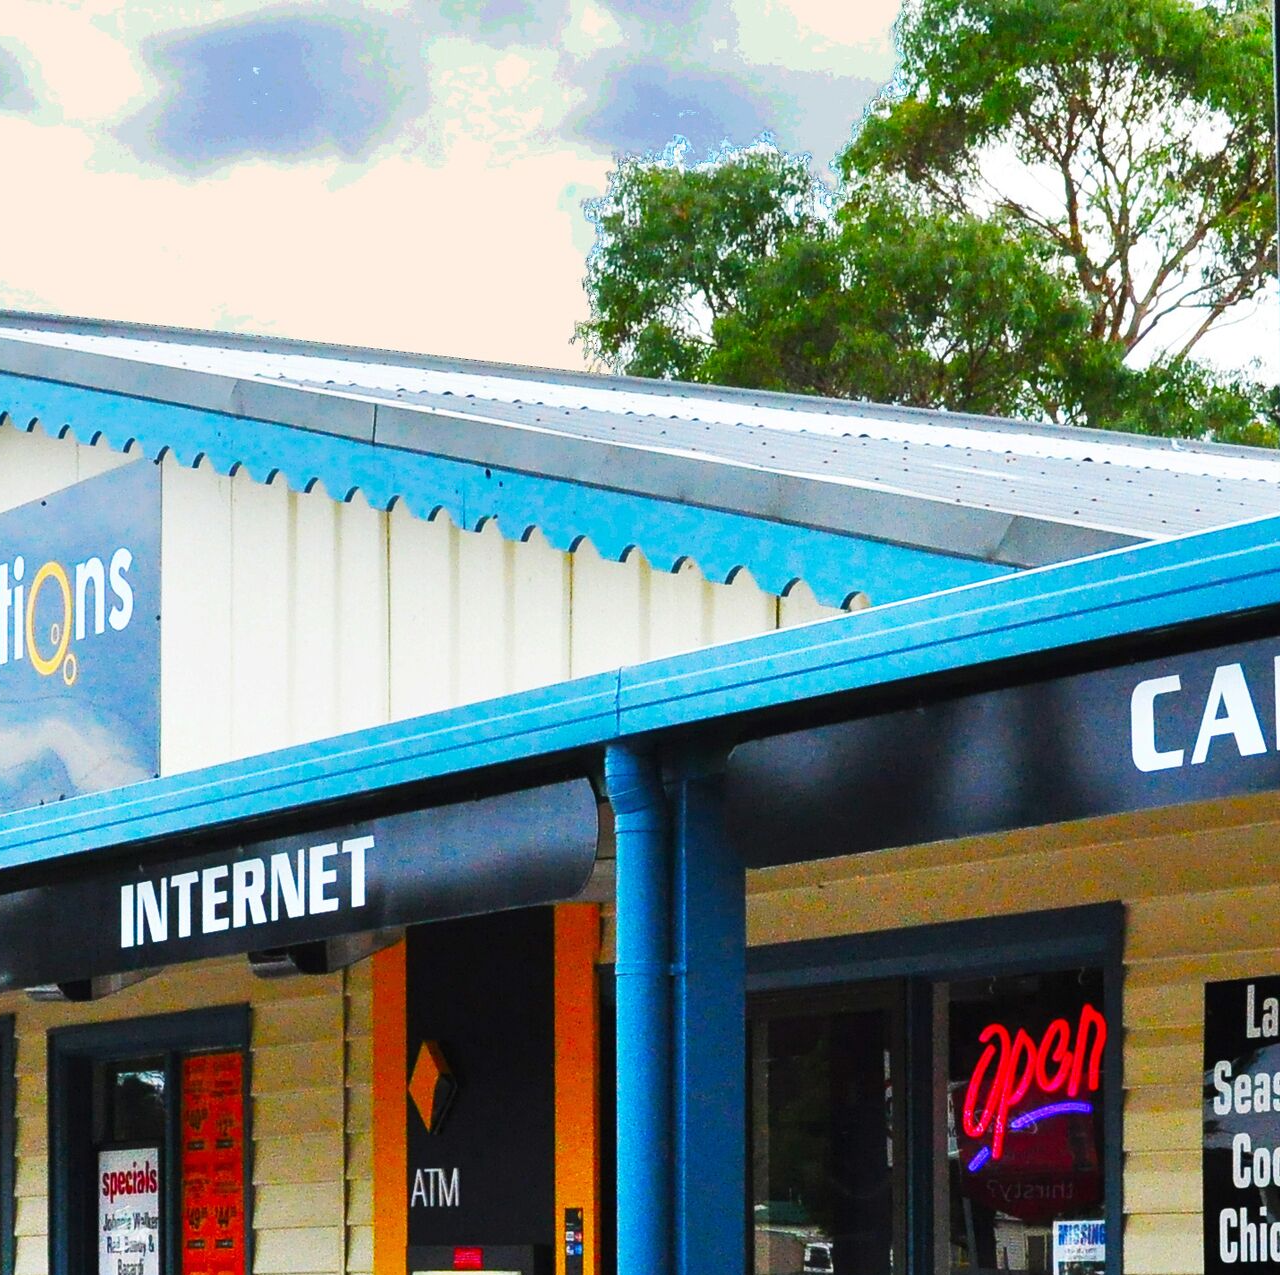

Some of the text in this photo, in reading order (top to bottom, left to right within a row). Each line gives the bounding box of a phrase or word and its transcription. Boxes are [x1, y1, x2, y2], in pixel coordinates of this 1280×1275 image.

[120, 835, 376, 950] INTERNET
[102, 1160, 158, 1204] specials
[410, 1167, 460, 1209] ATM
[1058, 1223, 1106, 1247] MISSING
